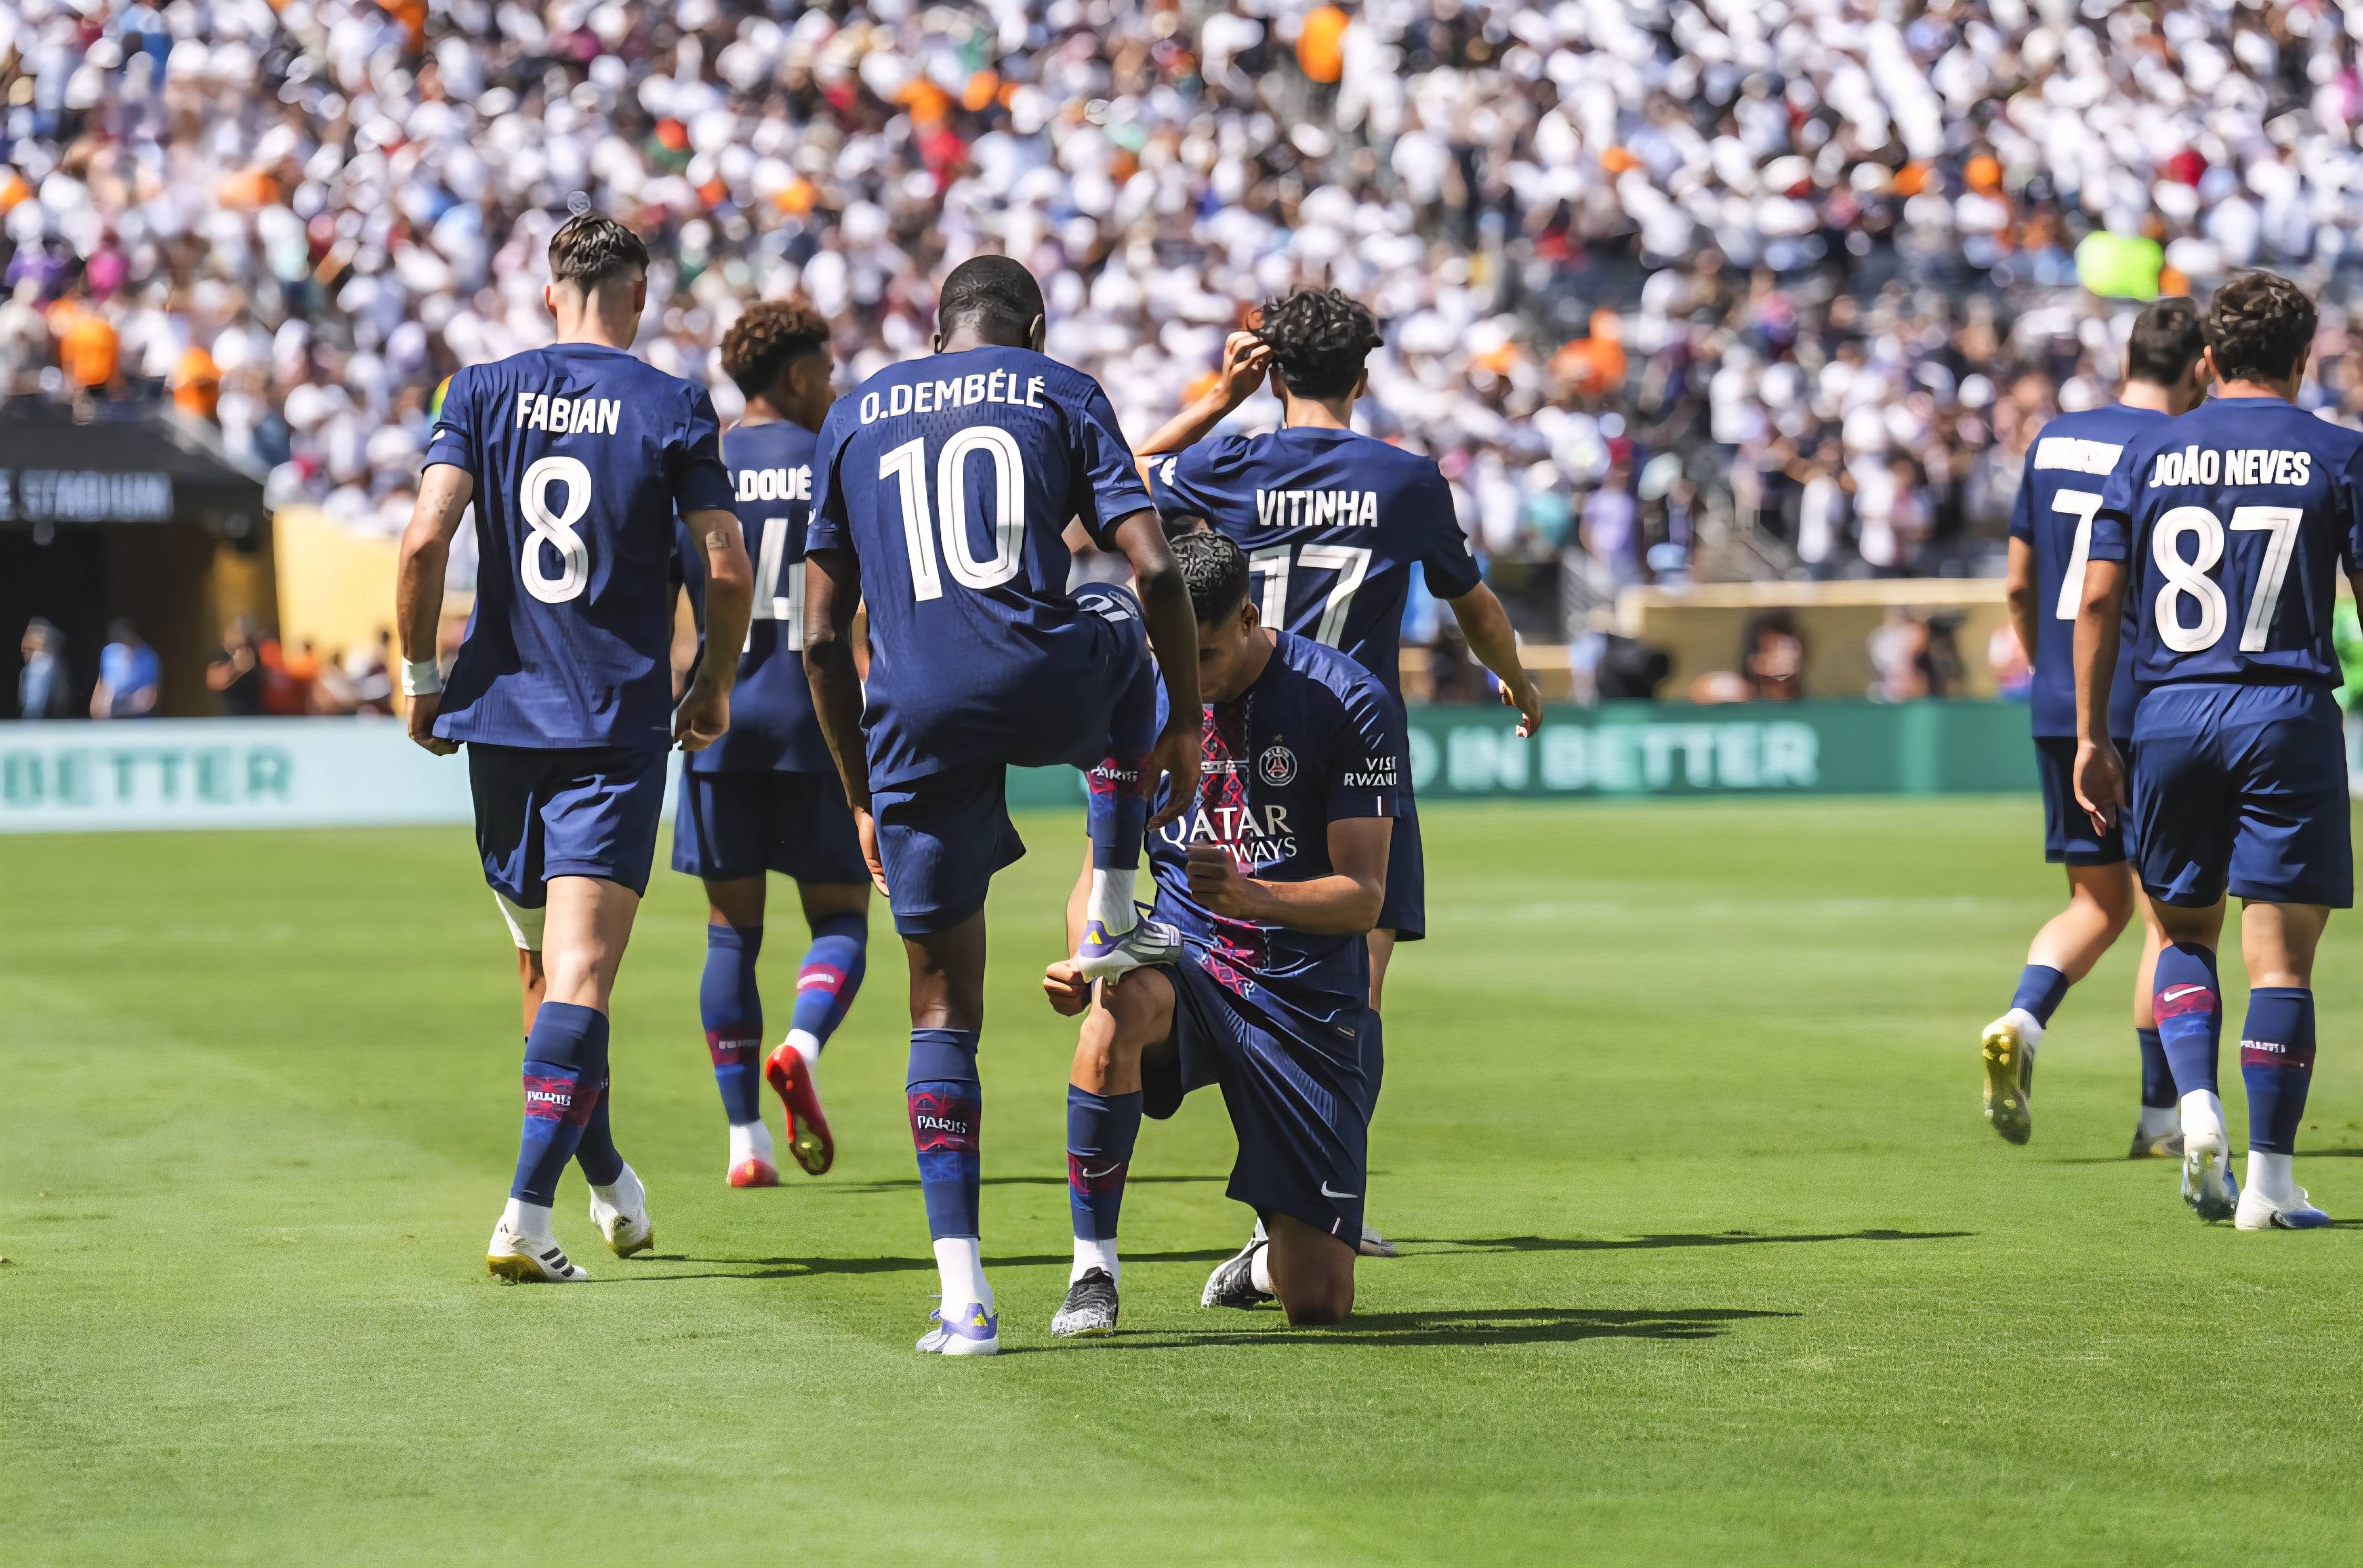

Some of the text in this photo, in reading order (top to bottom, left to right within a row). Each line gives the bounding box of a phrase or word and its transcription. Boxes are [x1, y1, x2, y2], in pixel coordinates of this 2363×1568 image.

[516, 391, 621, 435] FABIAN
[860, 368, 1045, 425] O.DEMBÉLÉ
[727, 464, 812, 502] .DOUÉ
[2224, 449, 2311, 486] NEVES
[519, 456, 592, 604] 8
[878, 425, 1025, 602] 10
[1256, 488, 1378, 528] VITINHA
[2051, 489, 2104, 621] 7
[2152, 506, 2304, 653] 87
[1250, 543, 1373, 650] 17
[2, 746, 294, 808] BETTER
[1448, 726, 1530, 792] IN
[1540, 722, 1820, 791] BETTER
[1159, 804, 1293, 852] QATAR
[917, 1115, 968, 1134] PARIS
